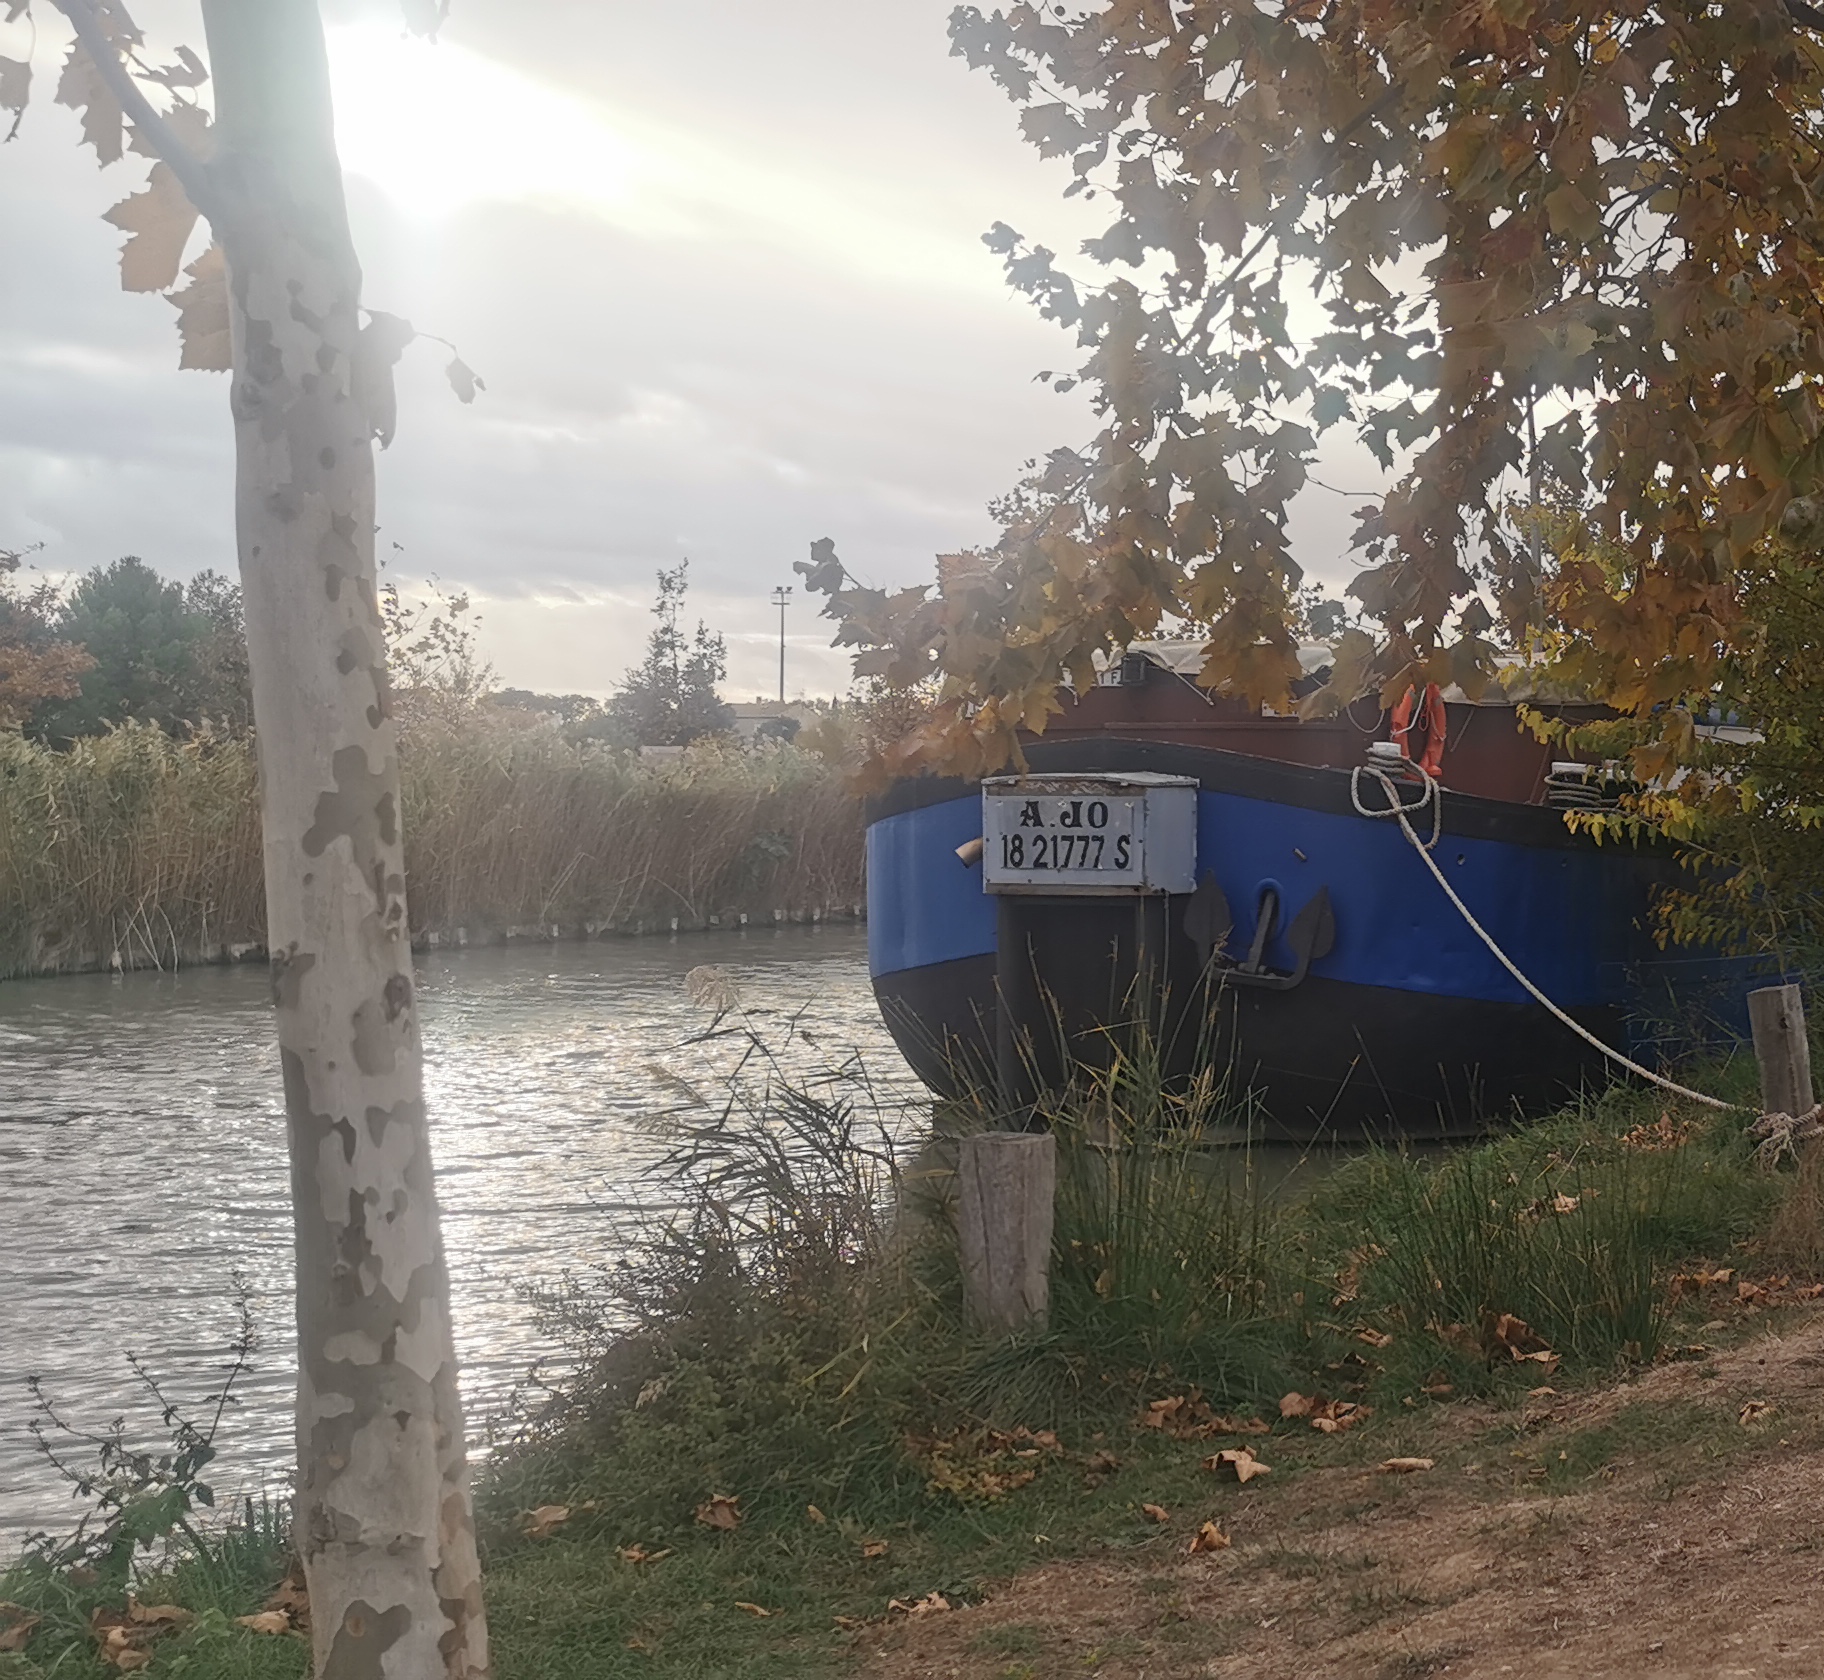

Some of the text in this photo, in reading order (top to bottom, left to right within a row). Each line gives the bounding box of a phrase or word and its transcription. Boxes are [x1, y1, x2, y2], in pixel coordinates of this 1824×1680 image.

[1001, 834, 1131, 870] 18 21777 S
